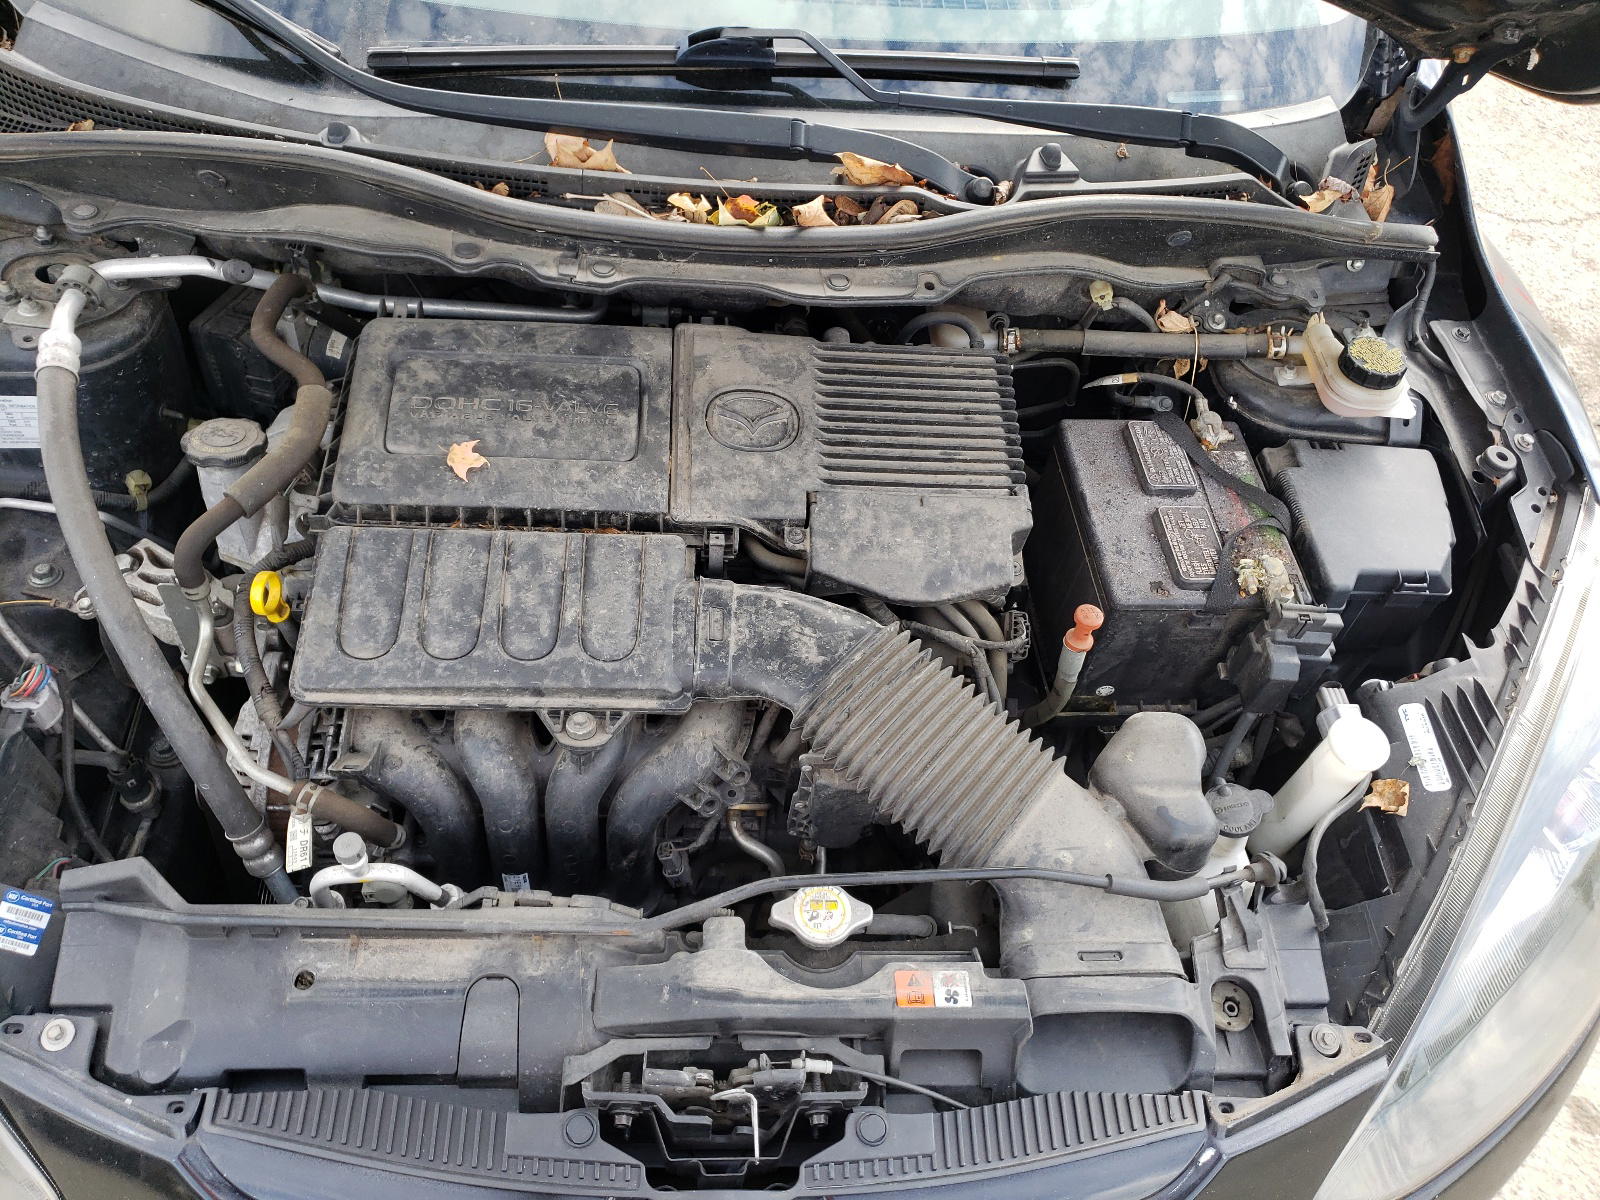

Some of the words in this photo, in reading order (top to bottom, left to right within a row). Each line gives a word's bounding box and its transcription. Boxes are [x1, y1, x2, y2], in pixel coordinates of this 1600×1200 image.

[410, 396, 501, 411] DOHC
[508, 398, 619, 416] 16-VALVE
[299, 839, 309, 863] DR61
